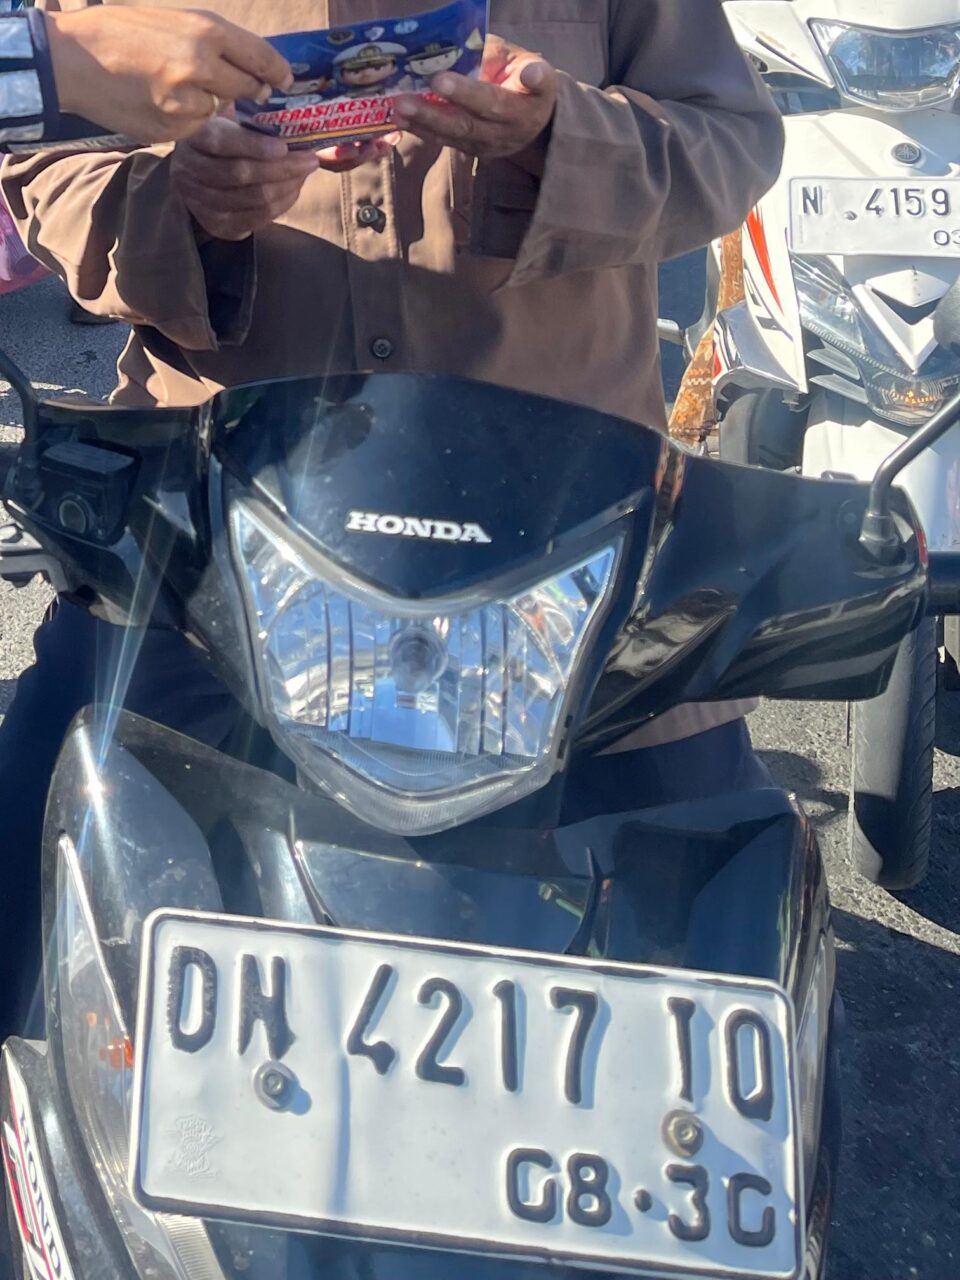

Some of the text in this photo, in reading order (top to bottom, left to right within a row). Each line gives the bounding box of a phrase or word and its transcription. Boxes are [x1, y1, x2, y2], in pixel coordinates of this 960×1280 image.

[865, 187, 951, 216] 4159
[345, 511, 492, 544] HONDA
[166, 945, 297, 1062] DN
[346, 963, 599, 1105] 4217
